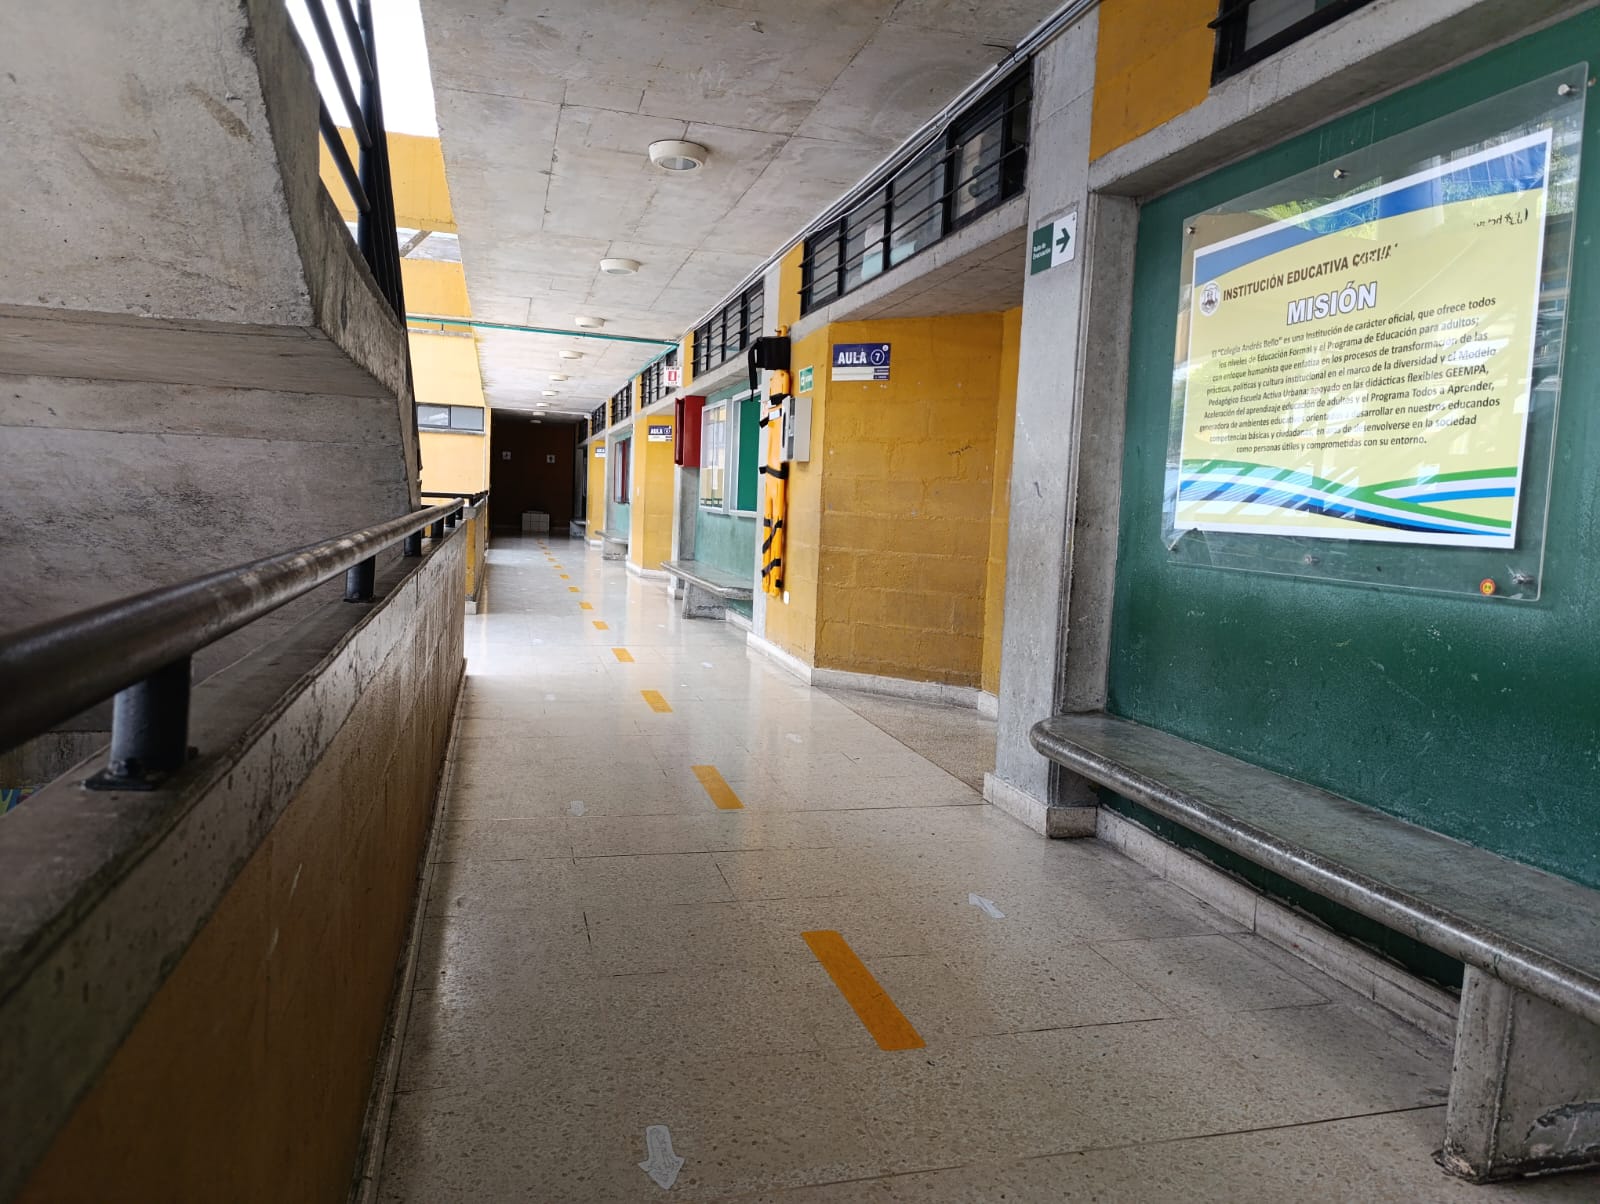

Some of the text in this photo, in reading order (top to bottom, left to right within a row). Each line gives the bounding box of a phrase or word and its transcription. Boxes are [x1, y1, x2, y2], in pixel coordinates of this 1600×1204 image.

[1223, 273, 1283, 300] INSTITUCIÓN
[1287, 256, 1349, 284] EDUCATIVA
[1286, 279, 1377, 325] MISIÓN
[1228, 357, 1247, 365] niveles
[1257, 349, 1287, 360] Educación
[1290, 344, 1311, 355] Formal
[1319, 342, 1325, 350] el
[1327, 338, 1362, 349] Programa
[1364, 334, 1373, 342] de
[1376, 327, 1416, 340] Educación
[1419, 324, 1438, 335] para
[1242, 341, 1261, 351] Andrés
[1344, 324, 1353, 332] de
[1355, 318, 1386, 330] carácter
[1388, 311, 1415, 324] oficial,
[1418, 310, 1434, 320] que
[1437, 304, 1465, 315] ofrece
[1468, 297, 1496, 309] todos
[838, 351, 881, 365] AULA 7
[1233, 382, 1256, 392] políticas
[1263, 378, 1283, 386] cultura
[1286, 370, 1326, 383] institucional
[1347, 366, 1370, 374] marco
[1372, 363, 1382, 371] de
[1394, 354, 1437, 368] diversidad
[1439, 356, 1445, 364] y
[1448, 352, 1456, 361] el
[1458, 347, 1496, 359] Modelo
[1248, 364, 1278, 375] humanista
[1280, 364, 1292, 372] que
[1294, 358, 1319, 368] enfatiza
[1344, 350, 1377, 362] procesos
[1379, 347, 1389, 355] de
[1391, 336, 1457, 353] transformación
[1460, 333, 1472, 343] de
[1474, 332, 1488, 340] las
[1209, 396, 1238, 405] Pedagógico
[1240, 393, 1261, 401] Escuela
[1263, 391, 1281, 399] Activa
[1311, 383, 1340, 394] apoyado
[1365, 376, 1405, 387] didácticas
[1407, 371, 1443, 382] flexibles
[1445, 364, 1489, 377] GEEMPA,
[1246, 404, 1280, 415] aprendizaje
[1282, 400, 1315, 410] educación
[1327, 396, 1353, 405] adultos
[1361, 394, 1369, 402] el
[1371, 392, 1409, 402] Programa
[1411, 388, 1436, 397] Todos
[1447, 382, 1494, 395] Aprender,
[1239, 418, 1269, 426] ambientes
[1408, 403, 1446, 412] nuestros
[1448, 398, 1500, 409] educandos
[1425, 419, 1432, 427] la
[1436, 415, 1477, 426] sociedad
[1253, 445, 1280, 453] personas
[1306, 439, 1361, 450] comprometidas
[1391, 436, 1427, 444] entorno.
